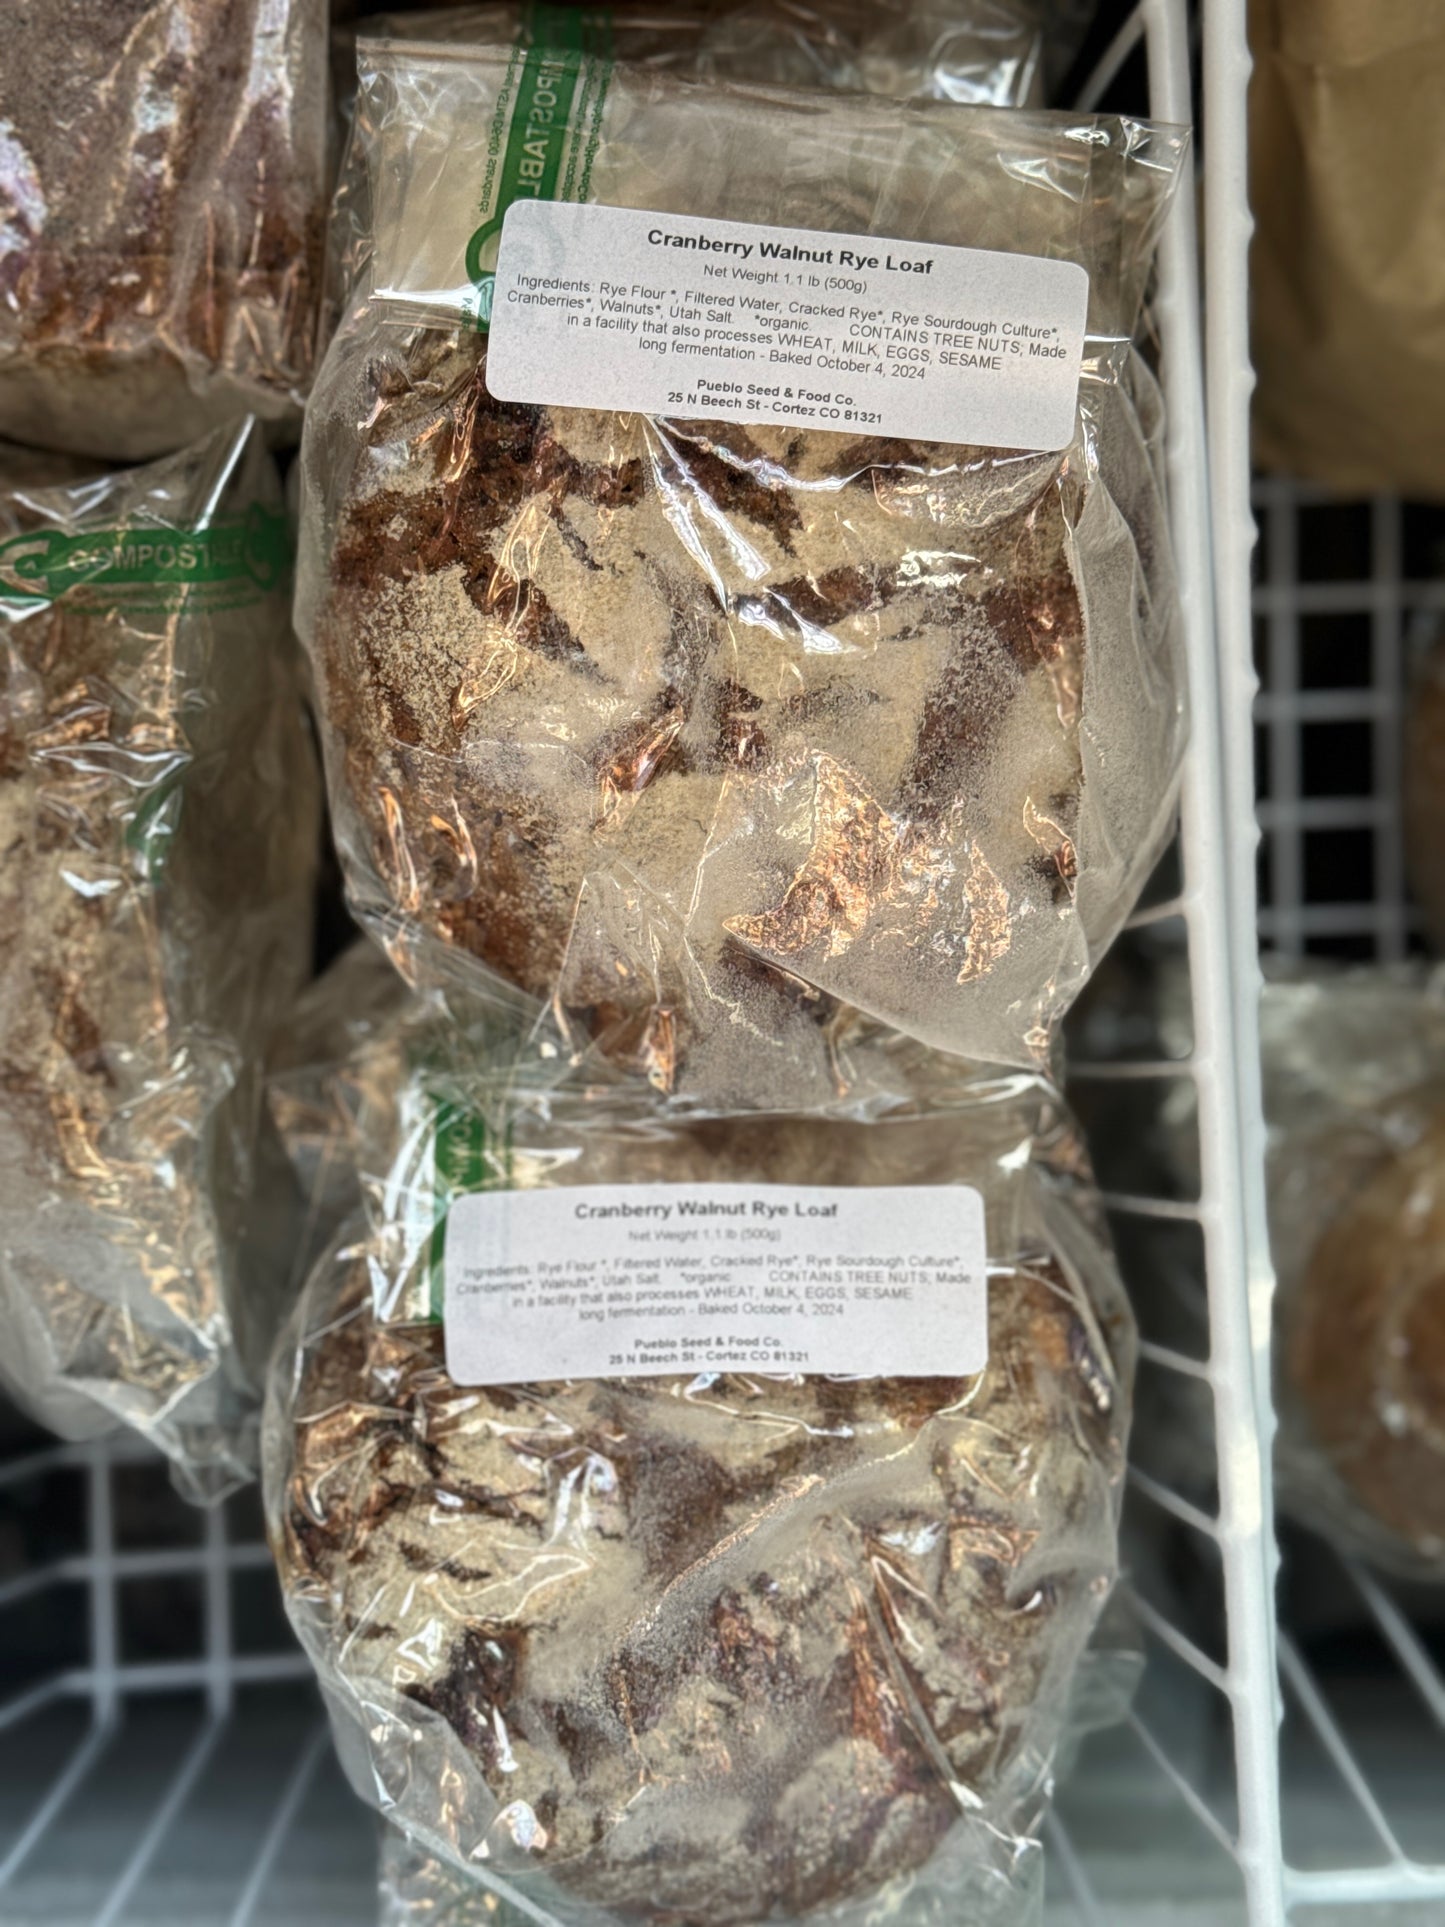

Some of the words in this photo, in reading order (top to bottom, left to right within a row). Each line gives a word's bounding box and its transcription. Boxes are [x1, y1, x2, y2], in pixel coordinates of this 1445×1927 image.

[647, 229, 754, 260] Cranberry
[759, 241, 834, 265] Walnut
[839, 250, 879, 271] Rye
[885, 255, 934, 275] Loaf
[703, 264, 728, 278] Net
[732, 267, 778, 285] Weight
[784, 272, 803, 286] 1.1
[808, 275, 820, 287] lb
[824, 277, 867, 295] (500g)
[517, 273, 595, 293] Ingredients:
[599, 281, 627, 298] Rye
[631, 285, 667, 300] Flour
[684, 290, 735, 307] Filtered
[739, 295, 782, 314] Water,
[788, 301, 845, 318] Cracked
[891, 311, 920, 328] Rye
[924, 314, 997, 336] Sourdough
[567, 313, 579, 326] in
[582, 317, 591, 327] a
[595, 315, 639, 334] facility
[642, 319, 668, 335] that
[672, 323, 701, 338] also
[704, 329, 773, 345] processes
[778, 333, 835, 354] WHEAT,
[842, 340, 880, 359] MILK,
[886, 344, 933, 365] EGGS,
[939, 351, 1003, 370] SESAME
[669, 305, 702, 321] Utah
[706, 309, 734, 324] Salt.
[849, 323, 929, 344] CONTAINS
[933, 332, 974, 349] TREE
[977, 337, 1024, 357] NUTS;
[1029, 342, 1067, 359] Made
[639, 336, 667, 355] long
[671, 339, 755, 361] fermentation
[769, 349, 812, 366] Baked
[817, 355, 871, 374] October
[874, 362, 886, 378] 4,
[891, 363, 925, 380] 2024
[697, 379, 743, 394] Pueblo
[746, 384, 780, 397] Seed
[783, 387, 794, 398] &
[797, 388, 831, 403] Food
[834, 393, 856, 406] Co.
[667, 391, 684, 403] 25
[687, 393, 697, 405] N
[701, 394, 742, 409] Beech
[746, 399, 761, 411] St
[772, 401, 816, 417] Cortez
[819, 407, 840, 419] CO
[844, 409, 882, 424] 81321
[574, 1202, 673, 1221] Cranberry
[676, 1200, 747, 1217] Walnut
[751, 1200, 790, 1219] Rye
[794, 1201, 839, 1218] Loaf
[628, 1230, 651, 1242] Net
[654, 1229, 698, 1244] Weight
[725, 1229, 738, 1240] lb
[740, 1228, 781, 1243] (500g)
[537, 1262, 563, 1274] Rye
[566, 1260, 597, 1272] Flour
[614, 1257, 661, 1269] Filtered
[710, 1255, 763, 1267] Cracked
[806, 1254, 832, 1268] Rye
[836, 1255, 904, 1269] Sourdough
[602, 1275, 631, 1286] Utah
[769, 1270, 842, 1283] CONTAINS
[848, 1271, 884, 1283] TREE
[936, 1272, 972, 1284] Made
[512, 1298, 523, 1308] in
[526, 1297, 535, 1308] a
[538, 1295, 576, 1307] facility
[580, 1293, 603, 1304] that
[607, 1292, 632, 1302] also
[636, 1290, 700, 1302] processes
[854, 1287, 912, 1301] SESAME
[579, 1310, 605, 1323] long
[608, 1306, 686, 1319] fermentation
[698, 1303, 738, 1316] Baked
[742, 1302, 792, 1316] October
[812, 1304, 844, 1316] 2024
[634, 1338, 678, 1349] Pueblo
[681, 1337, 712, 1348] Seed
[715, 1336, 725, 1347] &
[728, 1335, 760, 1347] Food
[609, 1354, 624, 1366] 25
[626, 1354, 636, 1364] N
[639, 1353, 678, 1364] Beech
[682, 1351, 696, 1362] St
[705, 1350, 747, 1362] Cortez
[750, 1350, 770, 1361] CO
[773, 1350, 809, 1362] 81321
